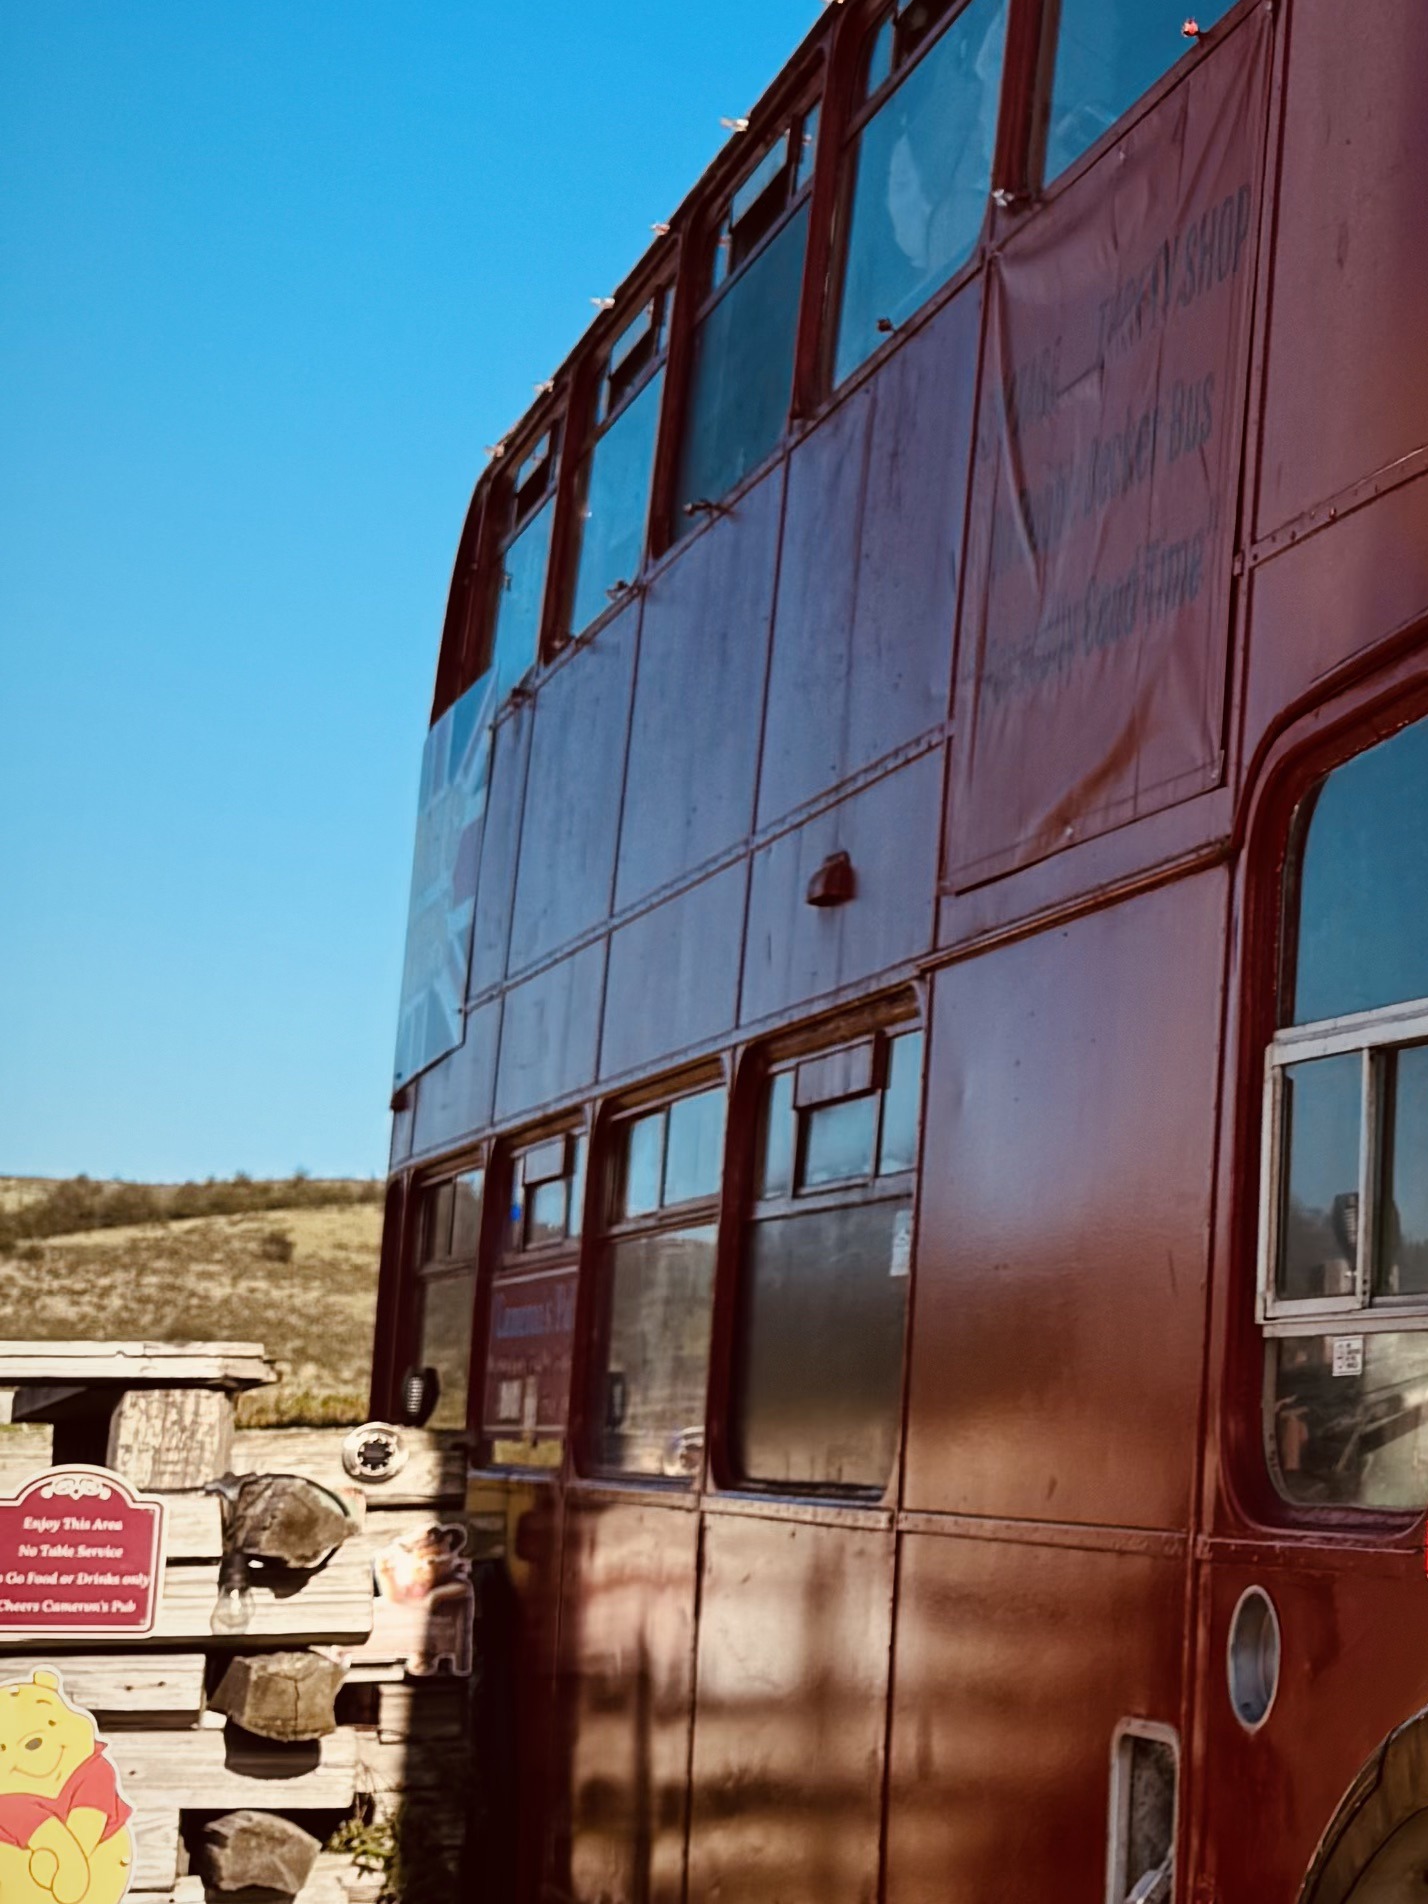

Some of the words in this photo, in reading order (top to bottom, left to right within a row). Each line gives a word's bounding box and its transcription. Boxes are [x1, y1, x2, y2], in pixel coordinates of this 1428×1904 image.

[23, 1516, 61, 1533] Enjoy
[63, 1516, 90, 1530] This
[92, 1517, 123, 1530] Area
[18, 1544, 38, 1557] No
[40, 1544, 75, 1558] Table
[77, 1544, 124, 1559] Service
[5, 1571, 25, 1585] Go
[27, 1571, 58, 1585] Food
[59, 1574, 74, 1585] or
[76, 1571, 120, 1586] Drinks
[122, 1572, 150, 1589] only
[111, 1599, 137, 1613] Pub
